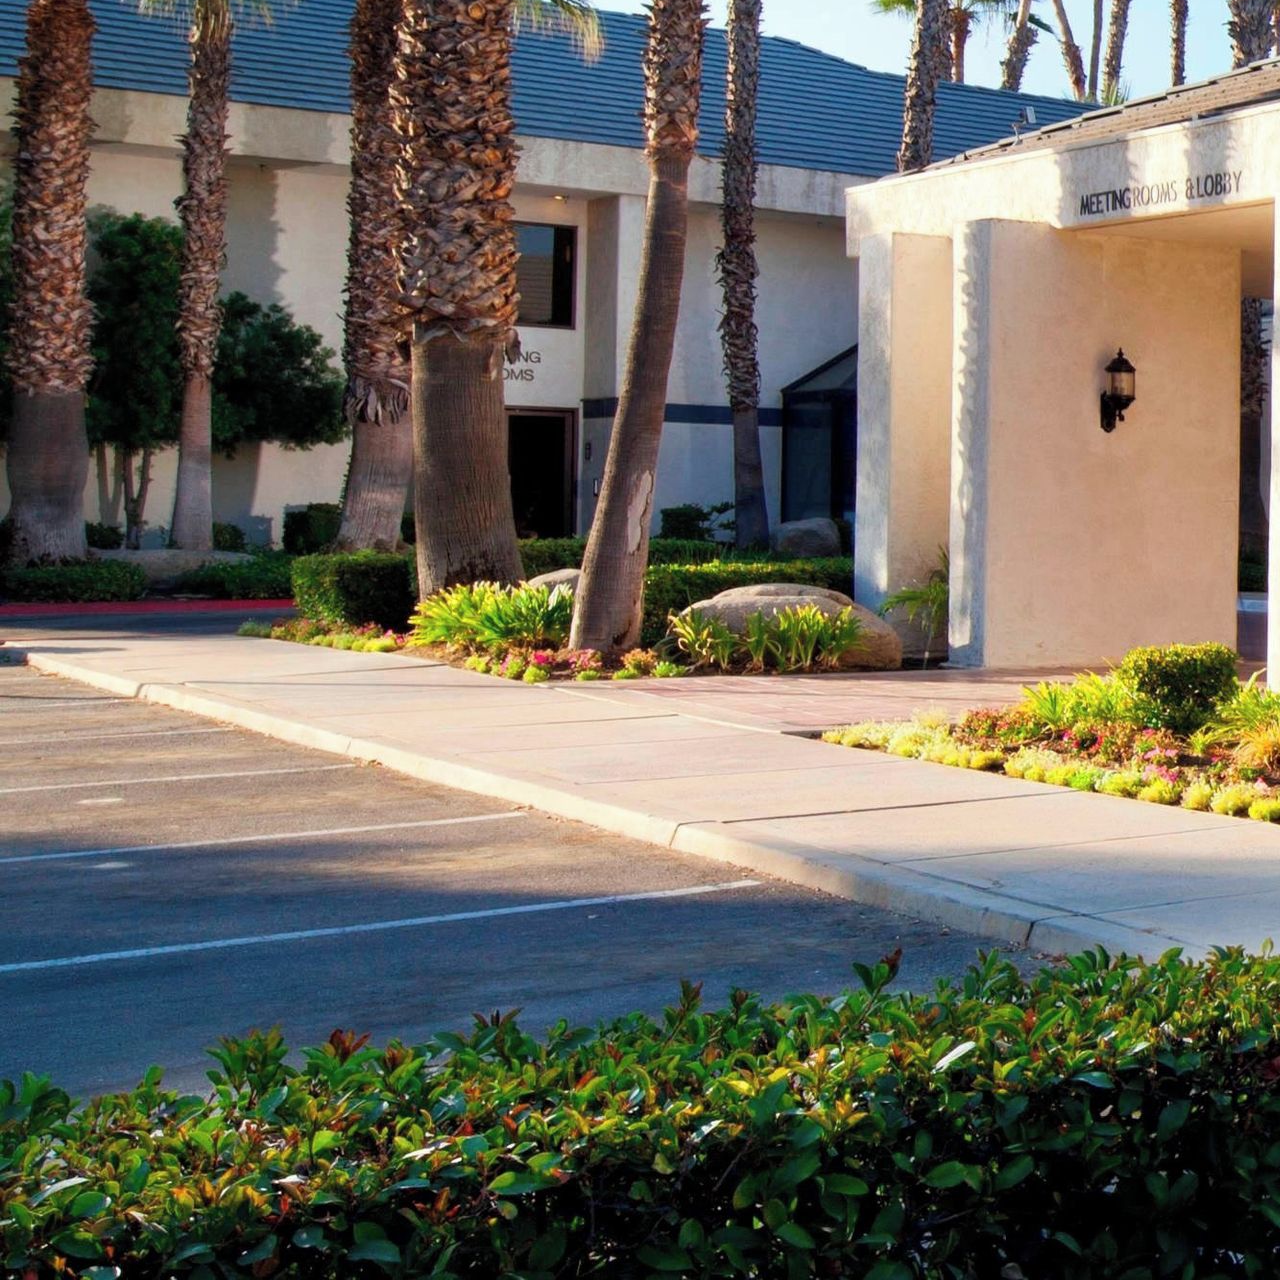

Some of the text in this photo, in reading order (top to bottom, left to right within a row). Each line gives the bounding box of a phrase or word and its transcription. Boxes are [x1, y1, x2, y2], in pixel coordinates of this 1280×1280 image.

[1080, 171, 1242, 216] MEETING ROOMS & LOBBY
[502, 368, 535, 382] OMS
